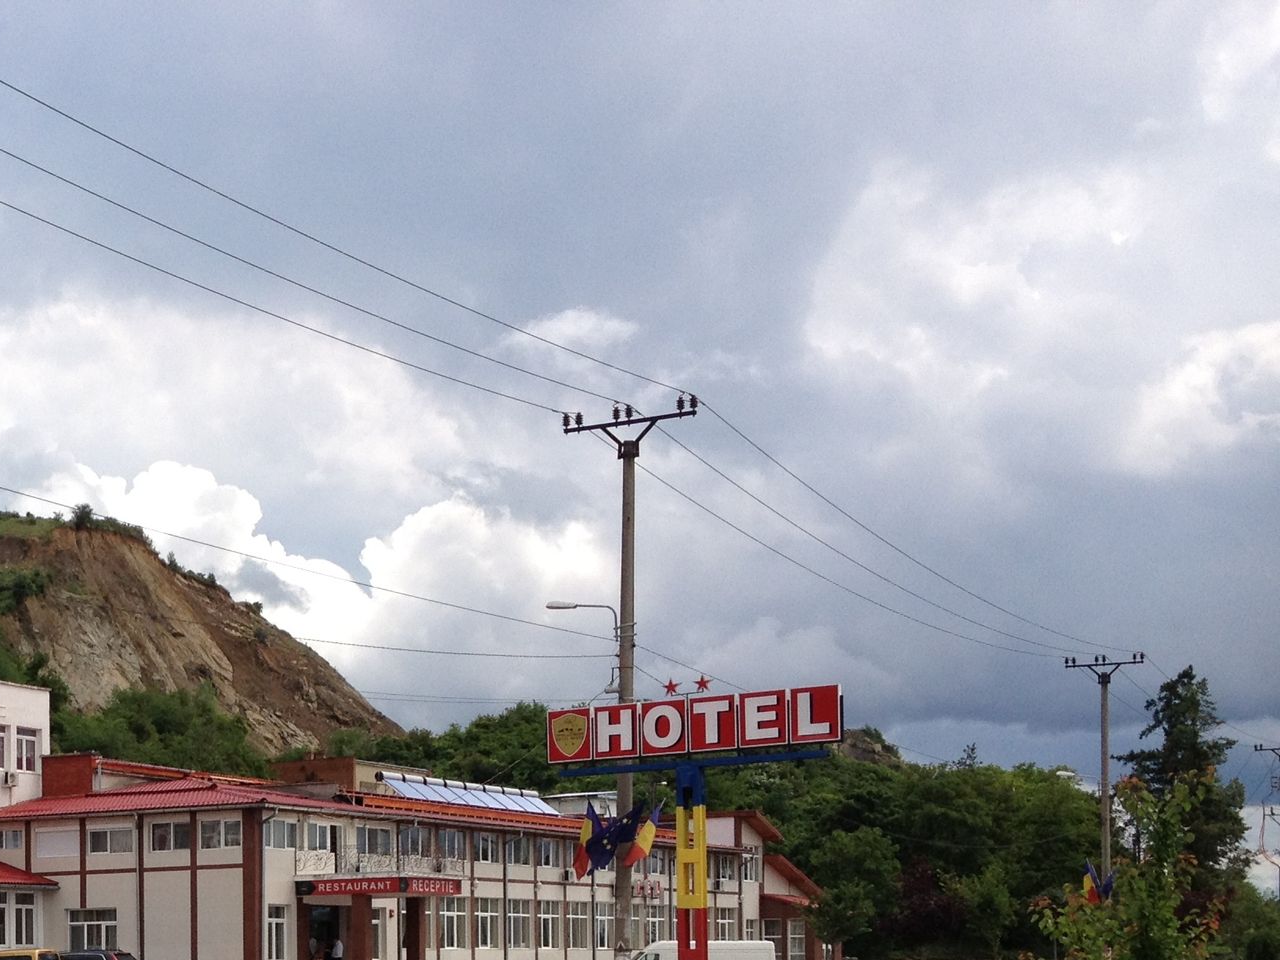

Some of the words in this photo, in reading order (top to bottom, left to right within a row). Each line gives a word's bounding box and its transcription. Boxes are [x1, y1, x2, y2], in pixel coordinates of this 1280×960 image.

[596, 691, 831, 753] HOTEL
[318, 880, 392, 892] RESTAURANT
[412, 879, 454, 893] RECEPTIE
